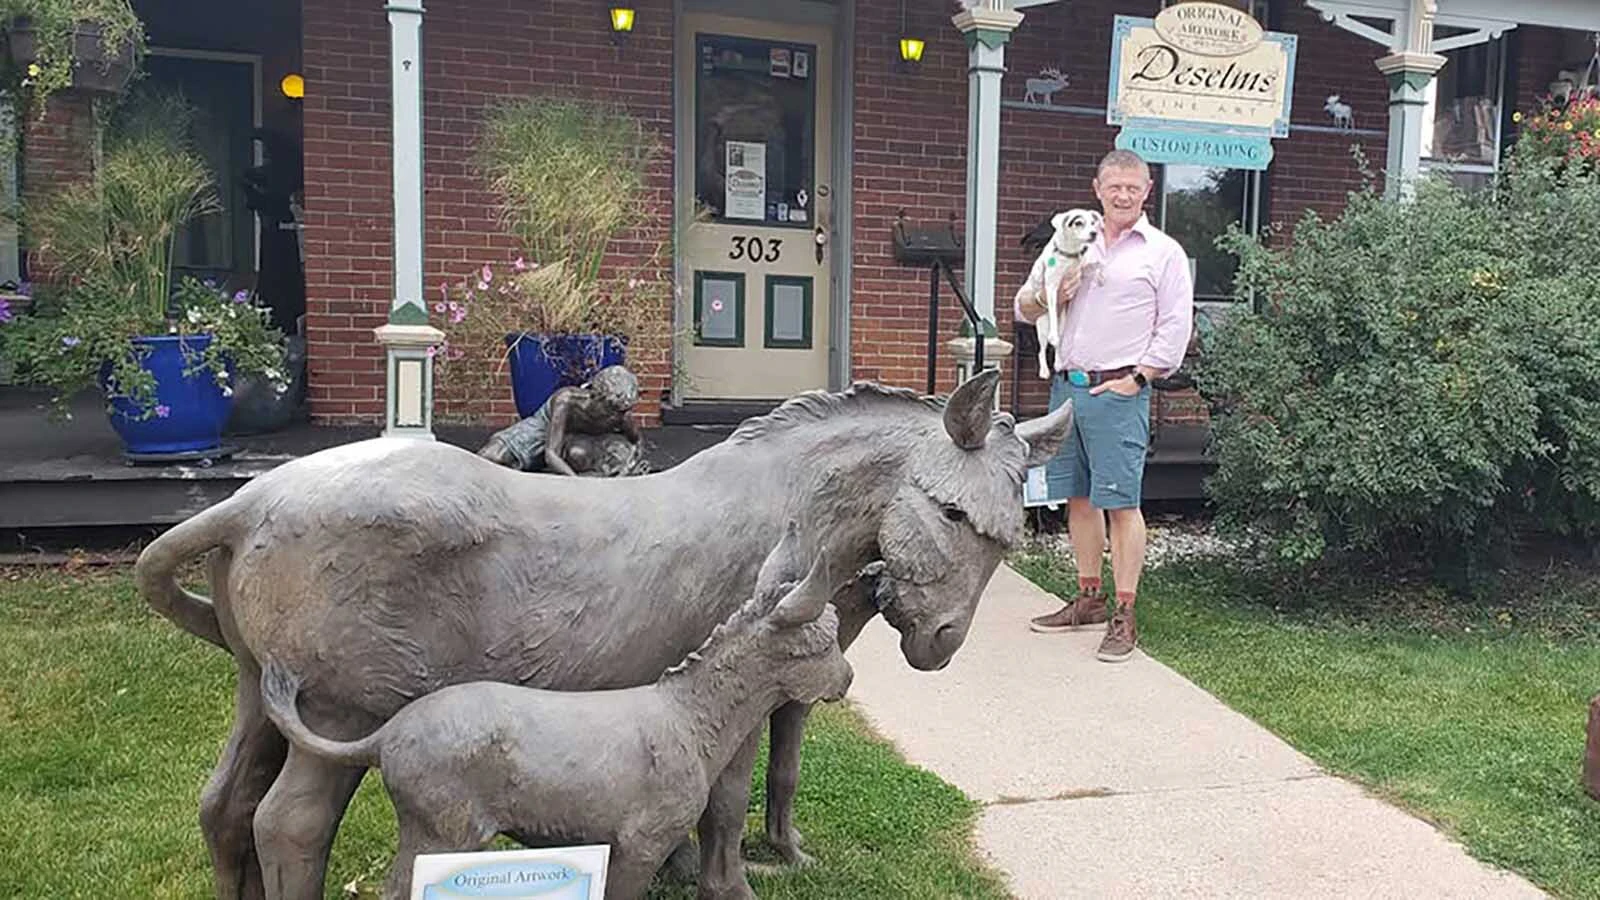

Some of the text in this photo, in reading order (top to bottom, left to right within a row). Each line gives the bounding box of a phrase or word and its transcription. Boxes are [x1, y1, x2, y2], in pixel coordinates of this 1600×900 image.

[1177, 7, 1243, 28] ORIGINAL
[1181, 24, 1241, 40] ARTWORK
[1131, 44, 1277, 93] Deselms
[1217, 104, 1257, 117] ART
[1132, 137, 1258, 160] CUSTOM FRAMING
[729, 236, 783, 263] 303
[454, 867, 570, 889] Original Artwork
